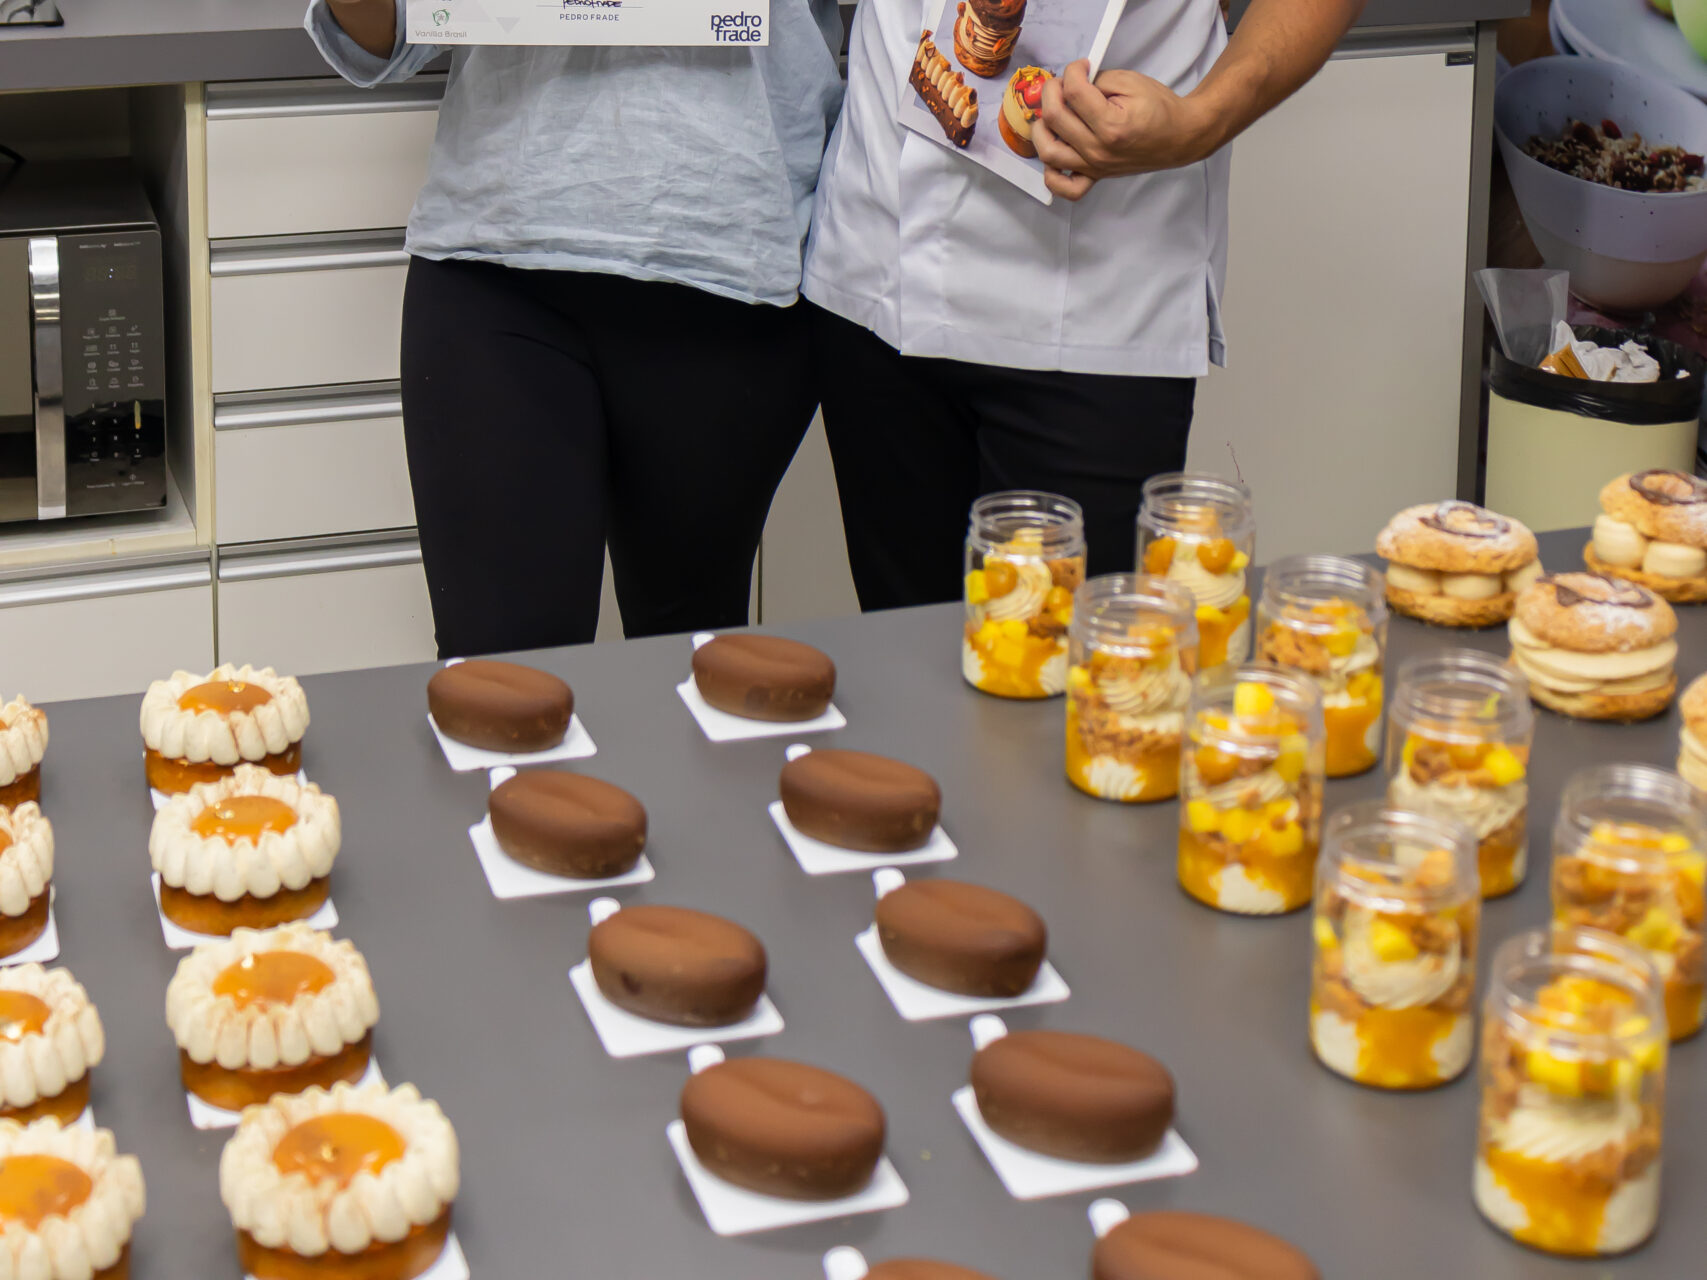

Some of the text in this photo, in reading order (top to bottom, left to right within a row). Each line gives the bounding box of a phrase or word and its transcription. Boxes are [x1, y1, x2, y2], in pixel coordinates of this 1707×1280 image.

[559, 13, 620, 22] PEDRO FRADE
[711, 11, 762, 30] pedro
[445, 30, 467, 38] Brasil
[715, 26, 762, 42] frade
